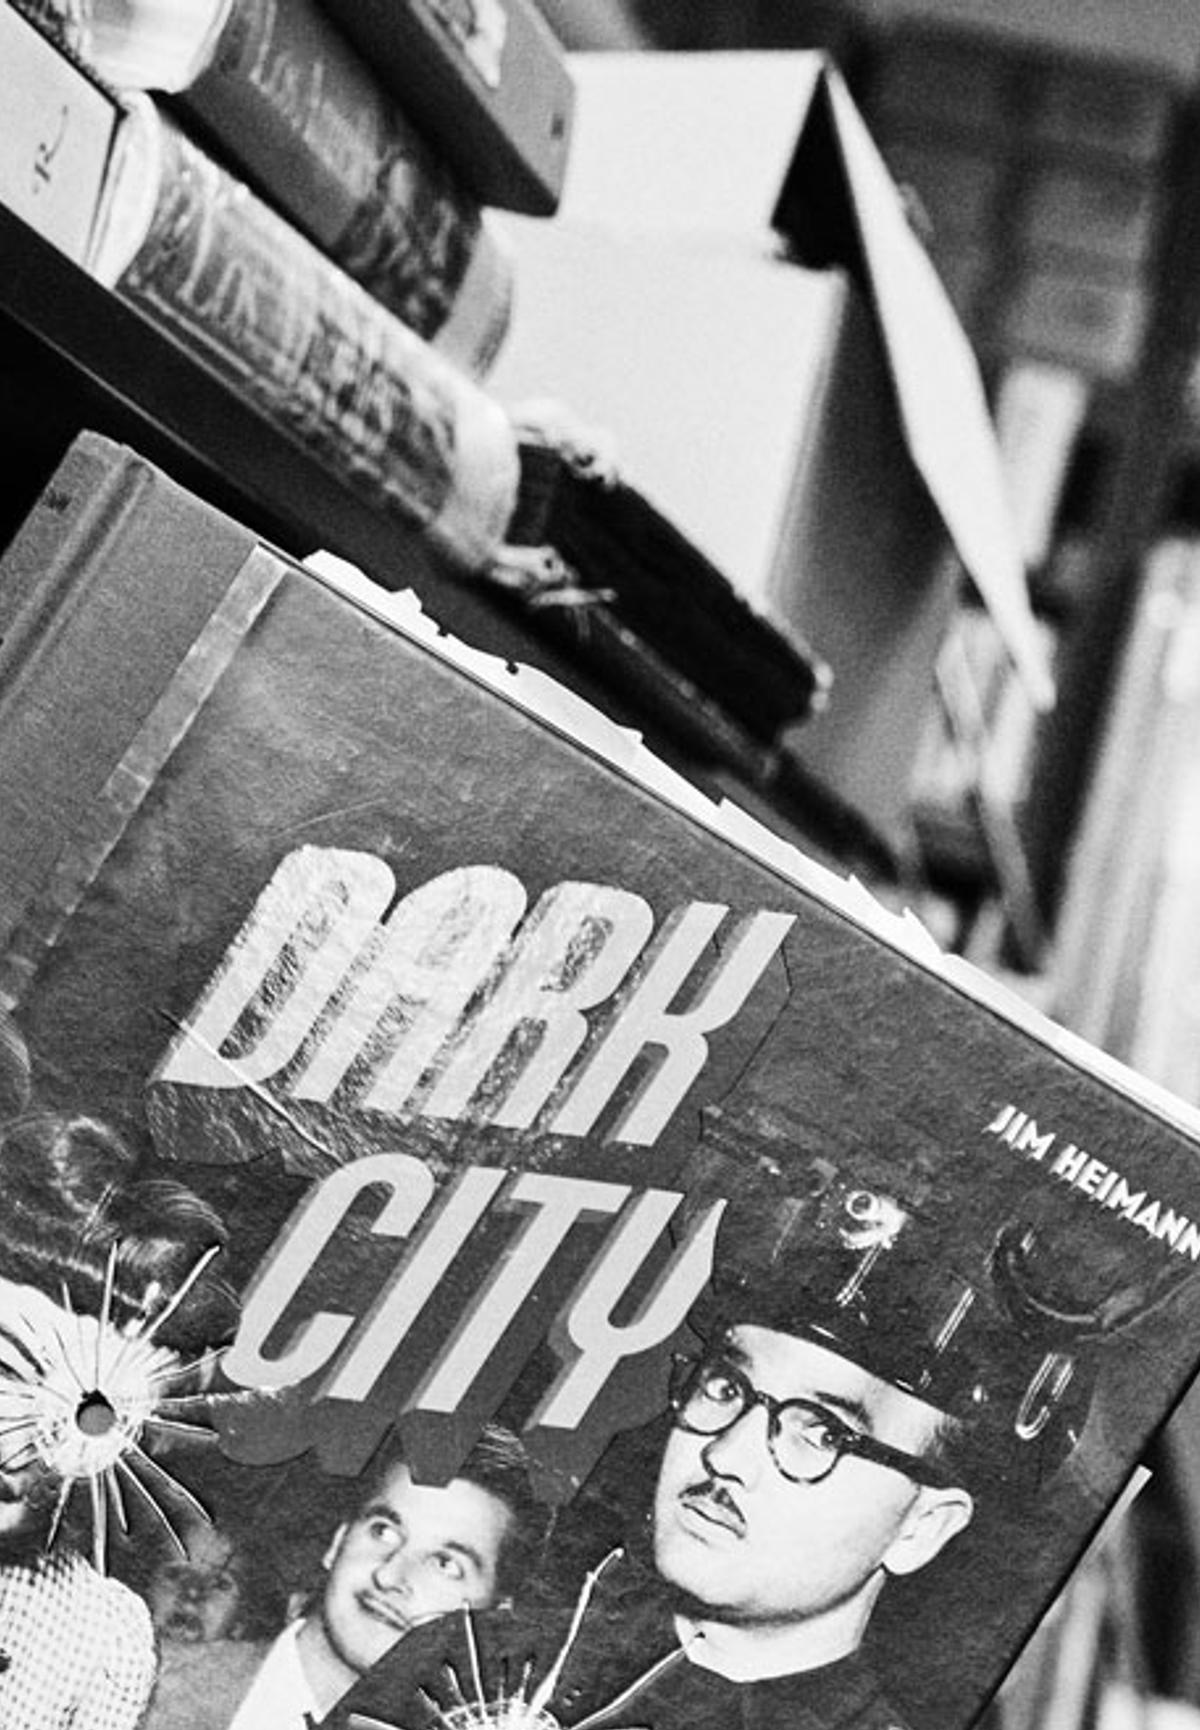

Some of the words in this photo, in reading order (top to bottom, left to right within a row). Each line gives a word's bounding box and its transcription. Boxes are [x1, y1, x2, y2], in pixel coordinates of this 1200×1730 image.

[158, 843, 798, 1148] DARK
[981, 1104, 1057, 1161] JIM
[219, 1152, 728, 1431] CITY
